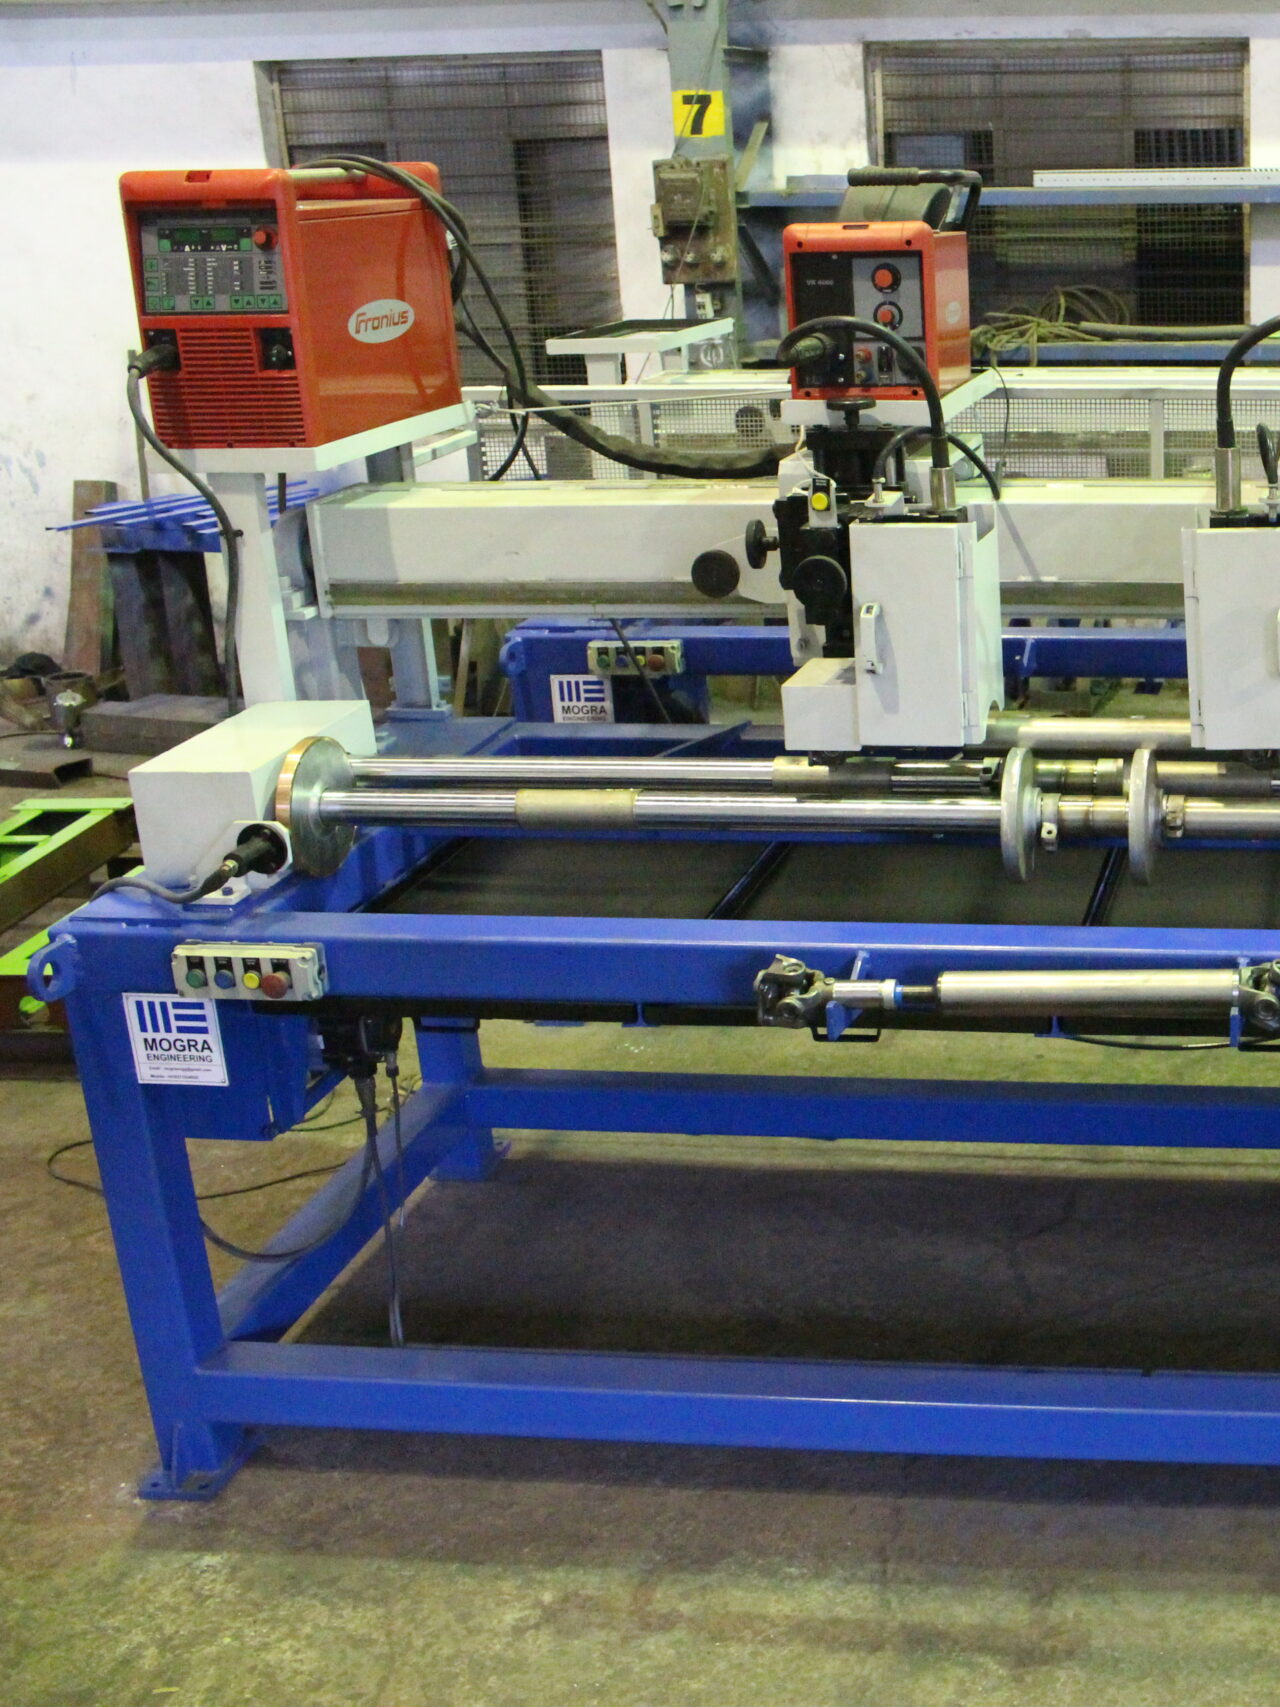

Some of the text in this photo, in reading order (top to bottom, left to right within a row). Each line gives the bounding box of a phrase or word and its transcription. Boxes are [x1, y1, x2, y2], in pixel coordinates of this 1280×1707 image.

[682, 94, 712, 135] 7
[355, 308, 409, 335] Fronius
[562, 704, 607, 715] MOGRA
[143, 1037, 213, 1053] MOGRA
[146, 1053, 213, 1063] ENGINEERING
